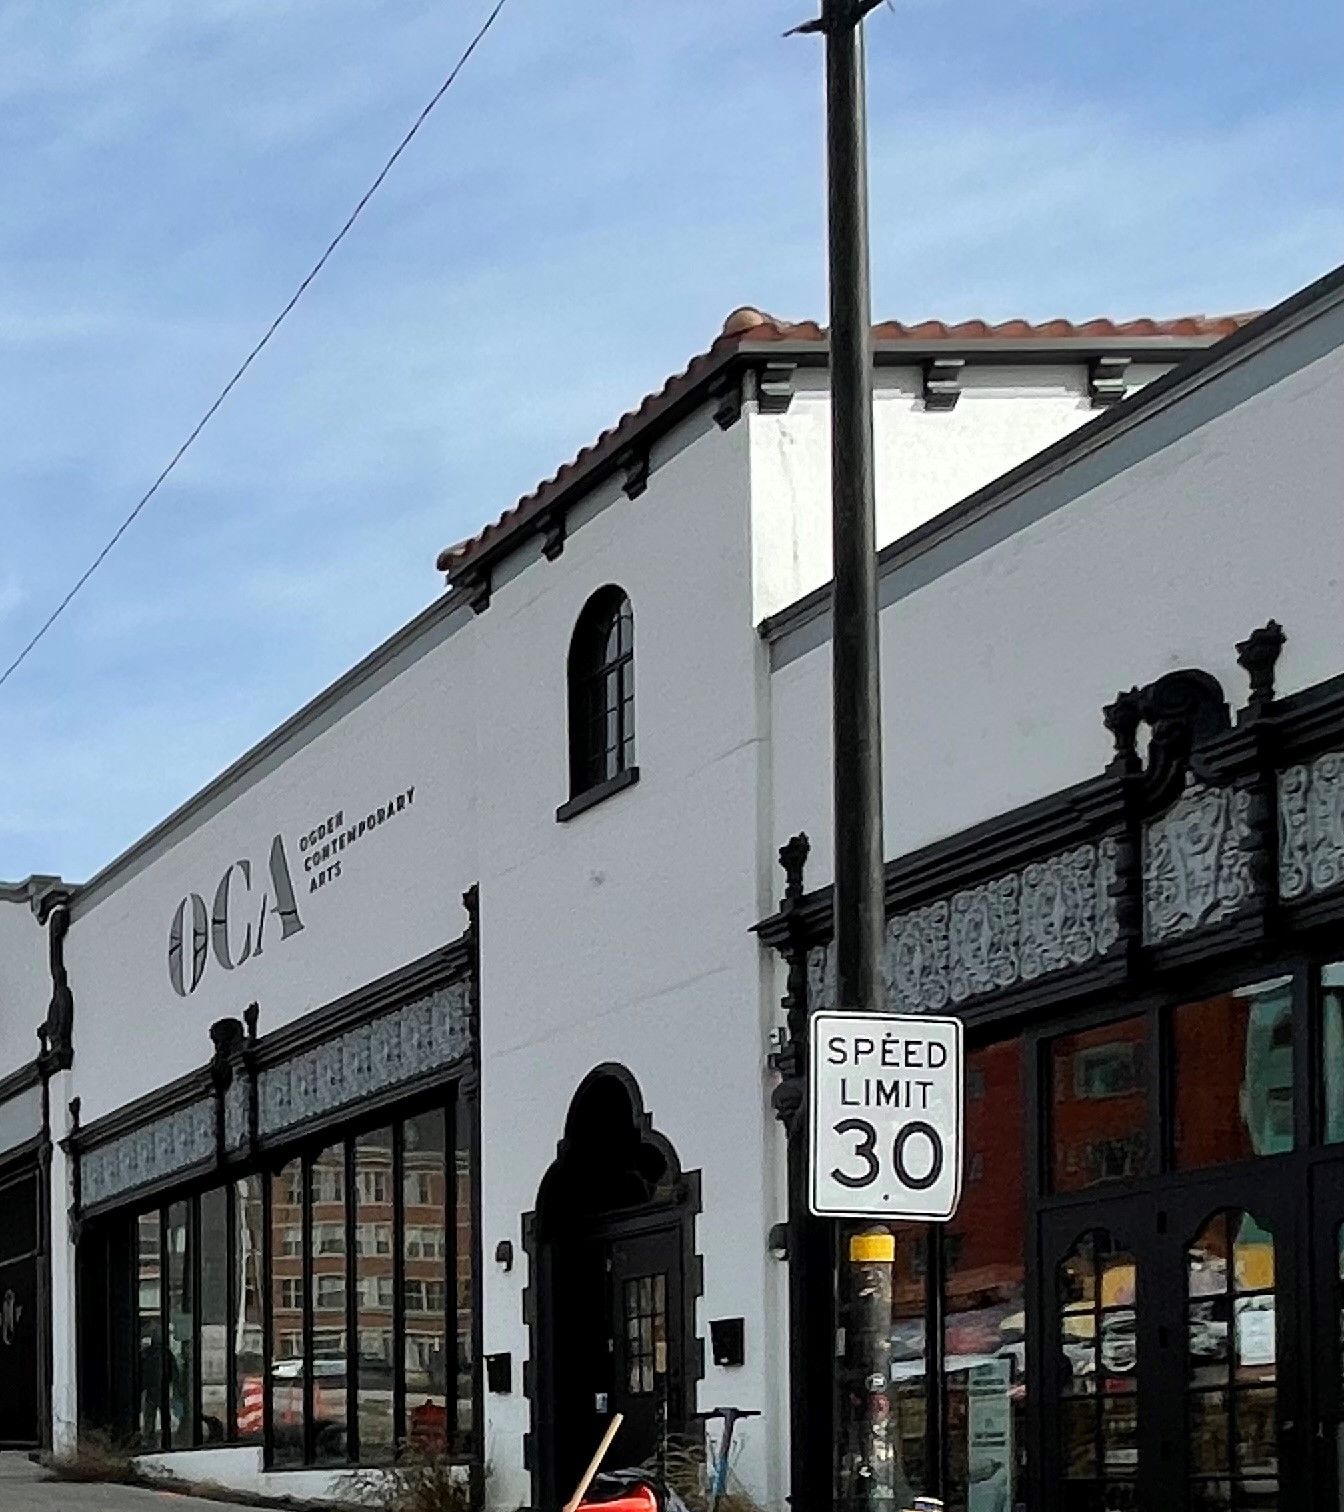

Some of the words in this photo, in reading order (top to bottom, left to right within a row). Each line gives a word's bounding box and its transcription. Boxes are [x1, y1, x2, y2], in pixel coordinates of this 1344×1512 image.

[299, 811, 344, 852] OGDEN
[304, 785, 415, 872] CONTEMPORARY
[310, 860, 342, 894] ARTS
[168, 833, 305, 998] OCA
[827, 1036, 948, 1069] SPEED
[841, 1078, 934, 1110] LIMIT
[831, 1118, 944, 1190] 30
